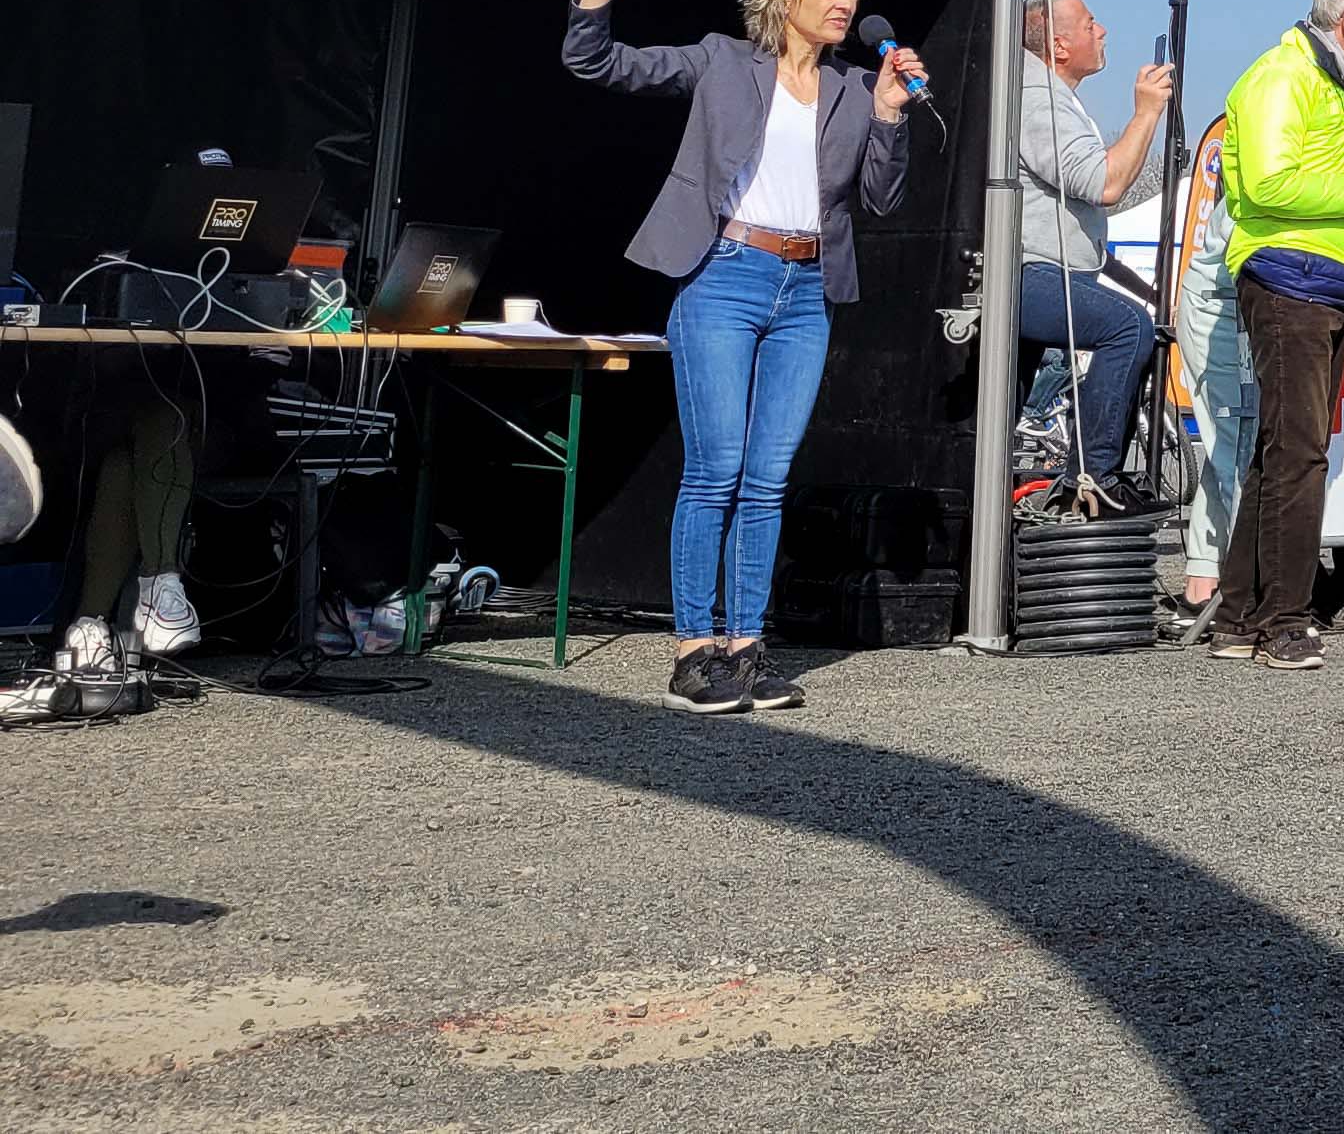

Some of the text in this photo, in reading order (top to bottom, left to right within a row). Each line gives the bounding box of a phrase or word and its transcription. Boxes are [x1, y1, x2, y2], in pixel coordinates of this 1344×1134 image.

[213, 207, 248, 219] PRO
[211, 218, 244, 228] TIMING
[430, 261, 452, 273] PRO
